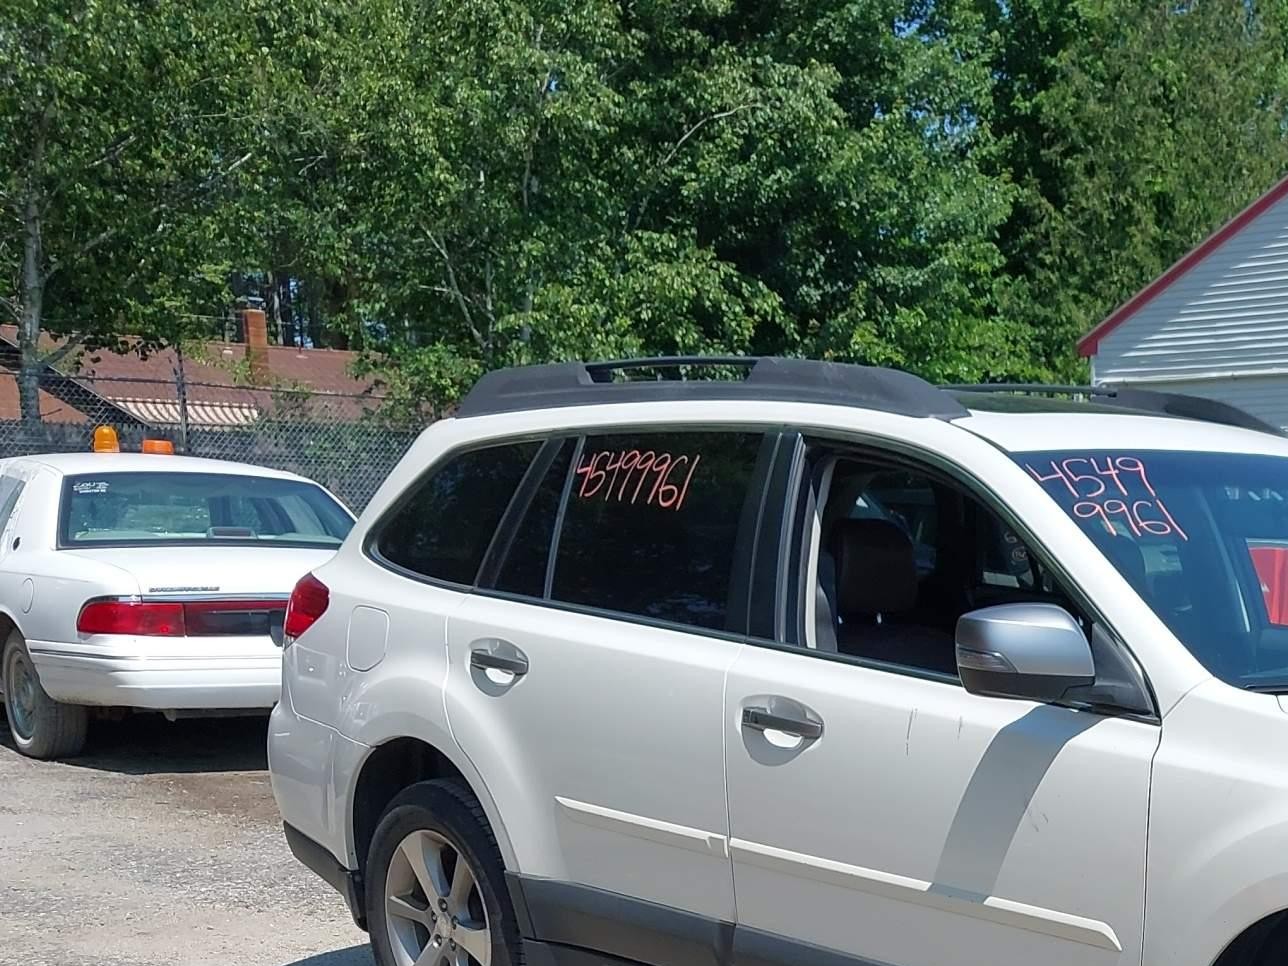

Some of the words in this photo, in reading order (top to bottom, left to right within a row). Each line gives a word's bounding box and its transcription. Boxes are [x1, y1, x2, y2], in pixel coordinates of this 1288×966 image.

[576, 450, 700, 511] 45499961
[1025, 456, 1156, 498] 4549
[1073, 499, 1188, 540] 9961
